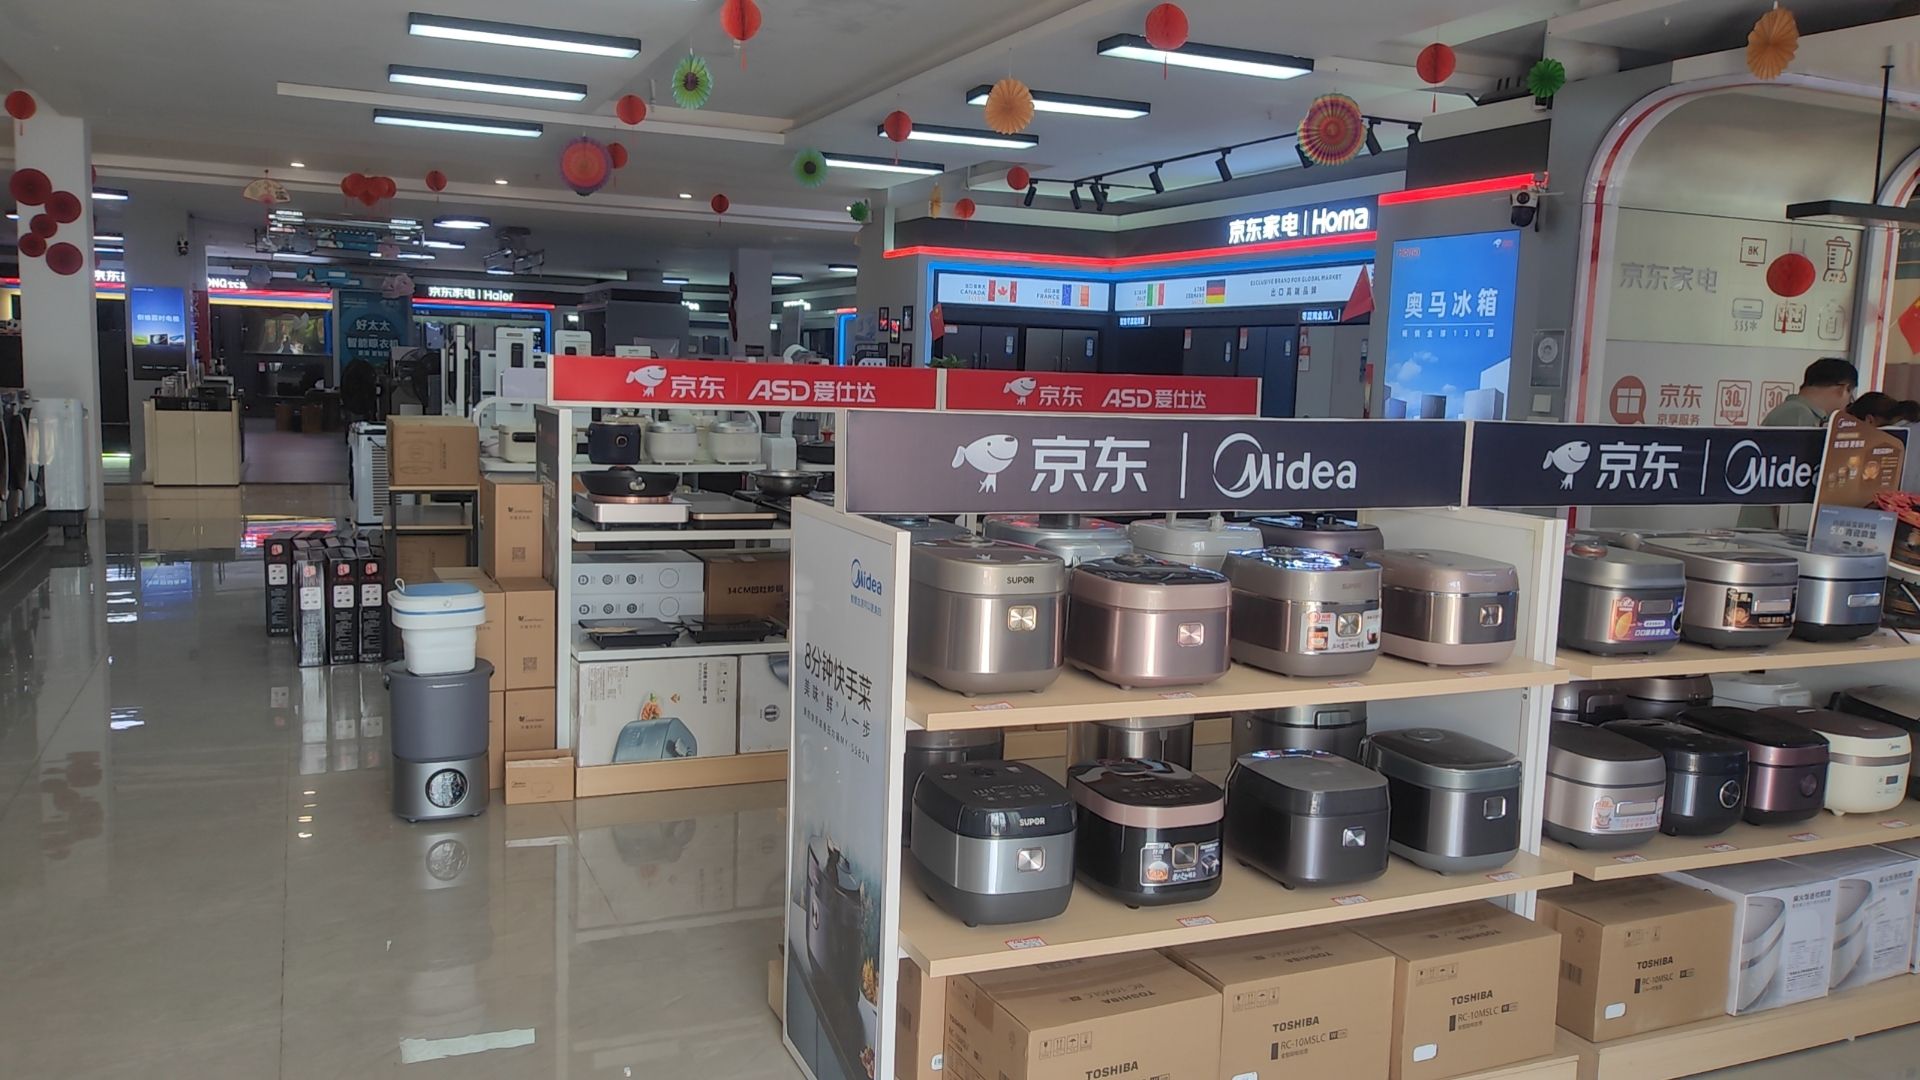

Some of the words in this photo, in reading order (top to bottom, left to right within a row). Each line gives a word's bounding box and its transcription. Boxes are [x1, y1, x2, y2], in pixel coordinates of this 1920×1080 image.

[1228, 212, 1299, 245] 京东家电
[1312, 206, 1369, 234] Homa
[95, 270, 125, 282] 京东
[1620, 261, 1718, 294] 京东家电
[428, 286, 476, 299] 京东家电
[483, 289, 514, 302] Haier
[1404, 287, 1498, 319] 奥马冰箱
[356, 320, 391, 331] 好太太
[670, 375, 726, 400] 京东
[747, 379, 811, 402] ASD
[813, 381, 876, 404] 爱仕达
[1039, 385, 1083, 407] 京东
[1101, 388, 1153, 408] ASD
[1155, 389, 1207, 410] 爱仕达
[1659, 383, 1703, 409] 京东
[1657, 413, 1700, 425] 京享服务
[1030, 435, 1150, 493] 京东
[1212, 432, 1357, 498] Midea
[1596, 440, 1683, 490] 京东
[850, 558, 882, 596] Midea
[1006, 575, 1035, 585] SUPOR
[804, 642, 872, 712] 8分钟快手菜
[1019, 817, 1046, 827] SUPOR
[1637, 956, 1673, 970] TOSHIBA
[1451, 989, 1493, 1006] TOSHIBA
[1457, 1006, 1499, 1022] RC-10MSLC
[1272, 1016, 1320, 1033] TOSHIBA
[1280, 1033, 1326, 1050] RC-10MSLC
[1085, 1061, 1139, 1080] TOSHIBA
